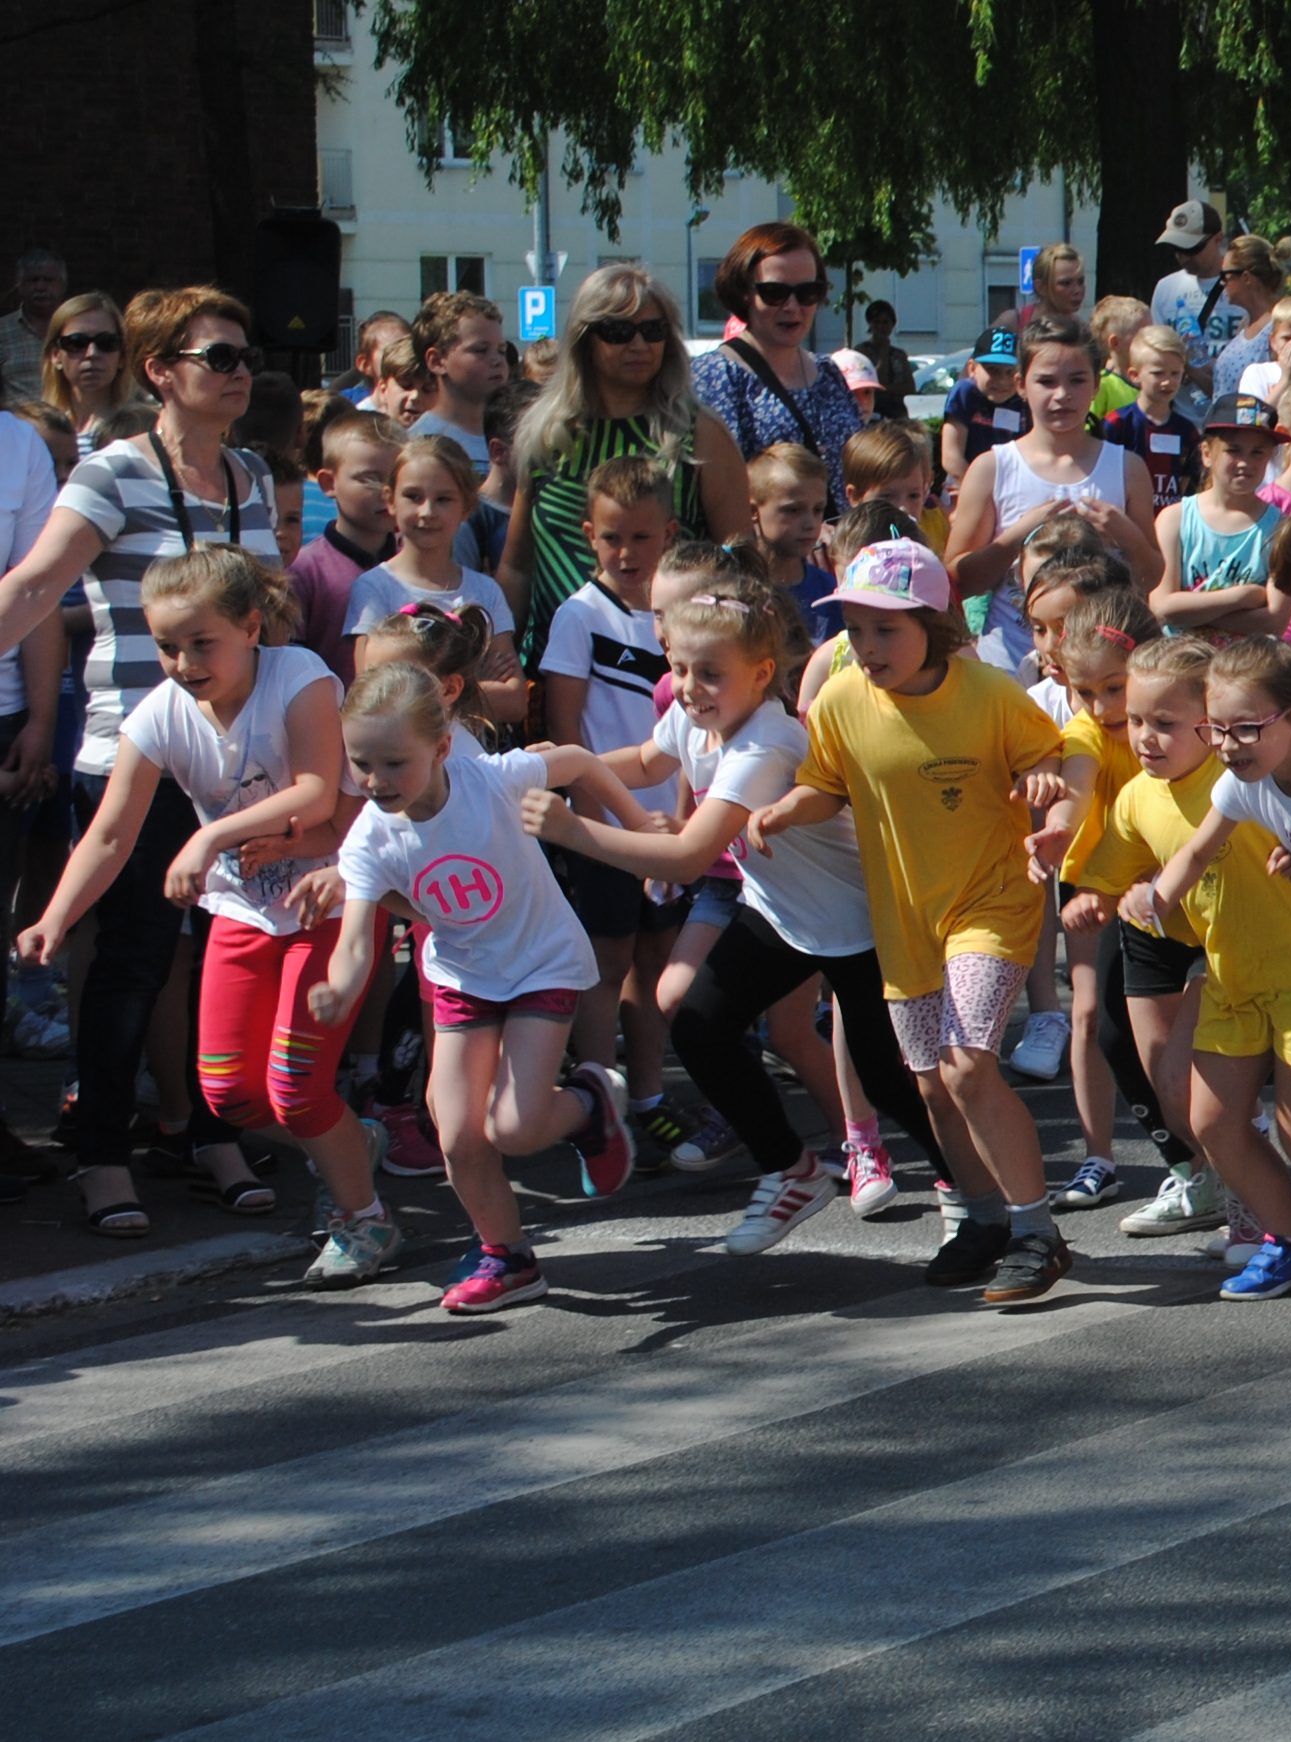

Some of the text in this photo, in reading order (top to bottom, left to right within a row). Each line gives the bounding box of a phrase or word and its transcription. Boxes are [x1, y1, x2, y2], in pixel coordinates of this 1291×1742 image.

[525, 291, 545, 325] P
[991, 332, 1014, 352] 23
[425, 867, 492, 914] 1H
